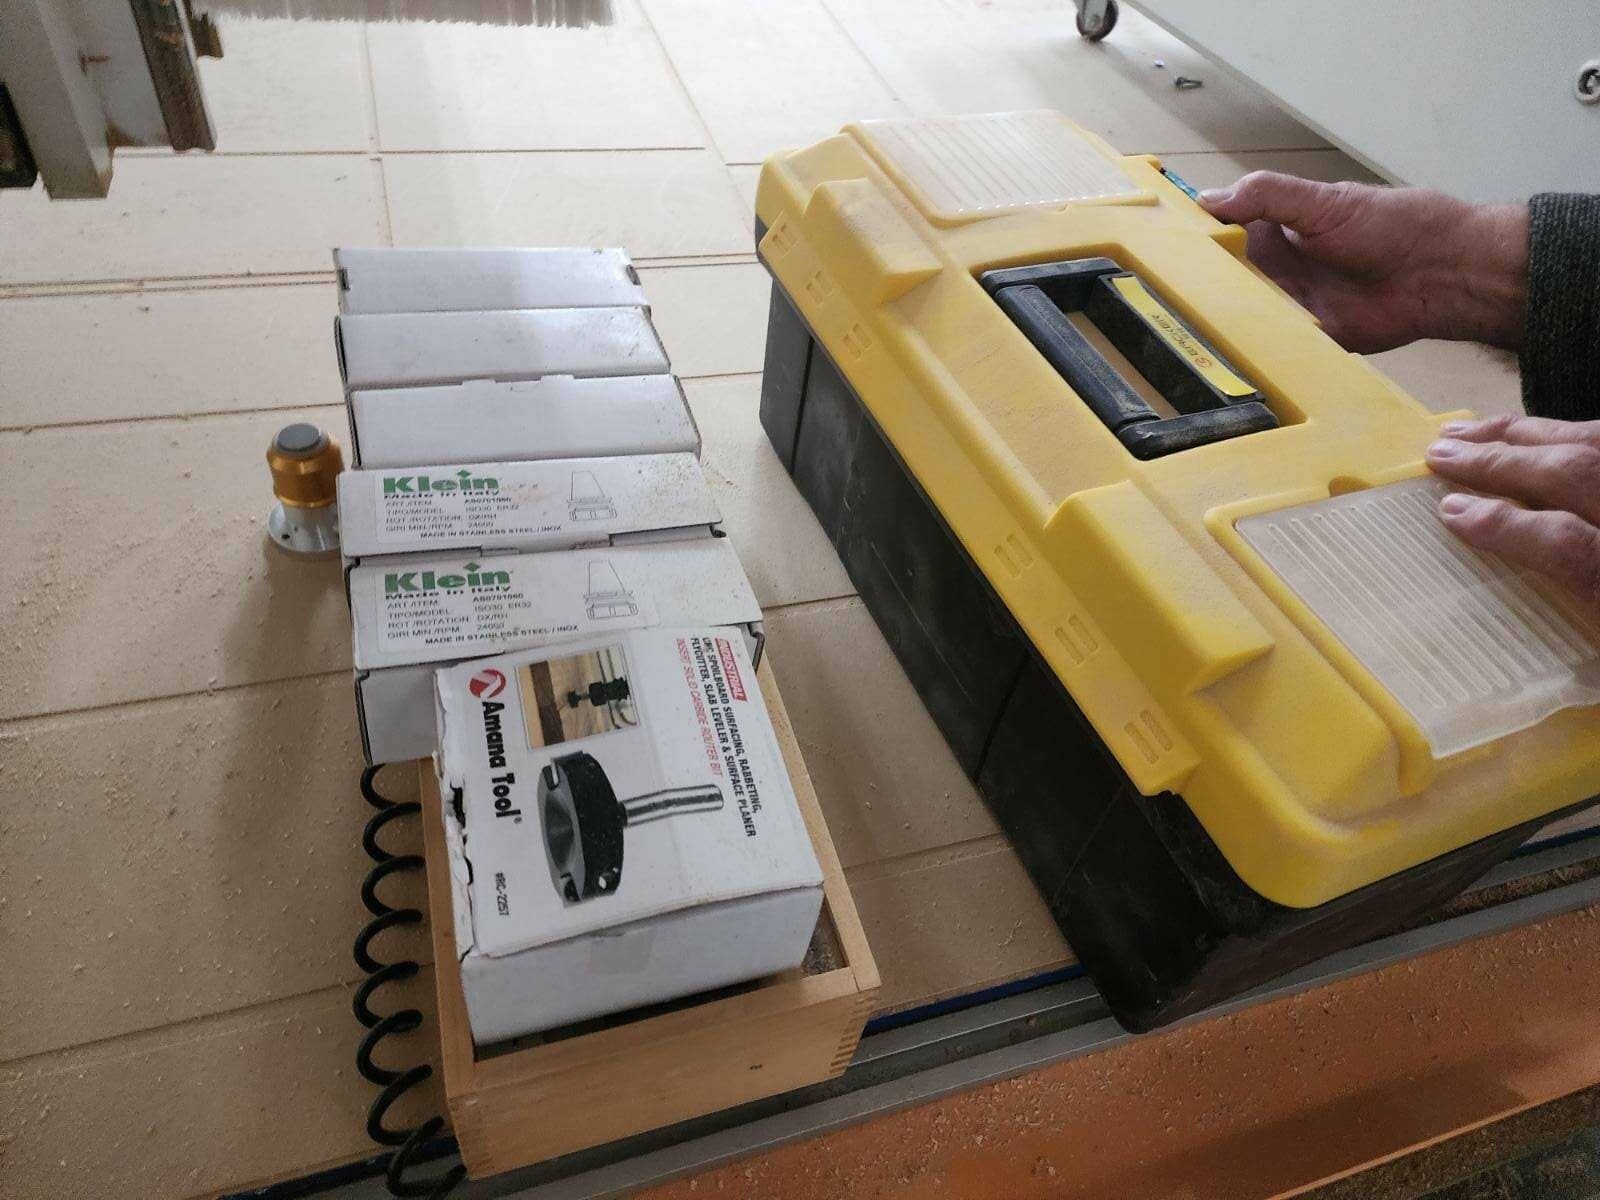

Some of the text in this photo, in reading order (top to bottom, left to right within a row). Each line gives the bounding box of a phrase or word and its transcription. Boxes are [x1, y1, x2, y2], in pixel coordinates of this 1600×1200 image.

[383, 469, 500, 493] Klein
[384, 489, 500, 499] Made in Italy
[420, 531, 446, 539] MADE
[459, 528, 506, 537] STAINLESS
[508, 527, 536, 535] STEEL
[384, 562, 510, 593] Klein
[385, 591, 440, 600] Made
[472, 585, 511, 594] Italy
[425, 636, 453, 645] MADE
[467, 629, 519, 640] STAINLESS
[520, 628, 550, 637] STEEL
[556, 625, 578, 633] INOX
[690, 637, 710, 682] FLYCUTTER,
[718, 639, 746, 701] INDUSTRIAL
[675, 637, 723, 778] INSERT SOLID CARBIDE ROUTER BIT
[703, 684, 718, 706] SLAB
[482, 701, 509, 769] Amana
[707, 655, 729, 705] SPOILBOARD
[723, 706, 745, 757] SURFACING,
[738, 759, 762, 814] RABBETING,
[710, 707, 729, 744] LEVELER
[724, 755, 745, 797] SURFACE
[737, 799, 757, 838] PLANER
